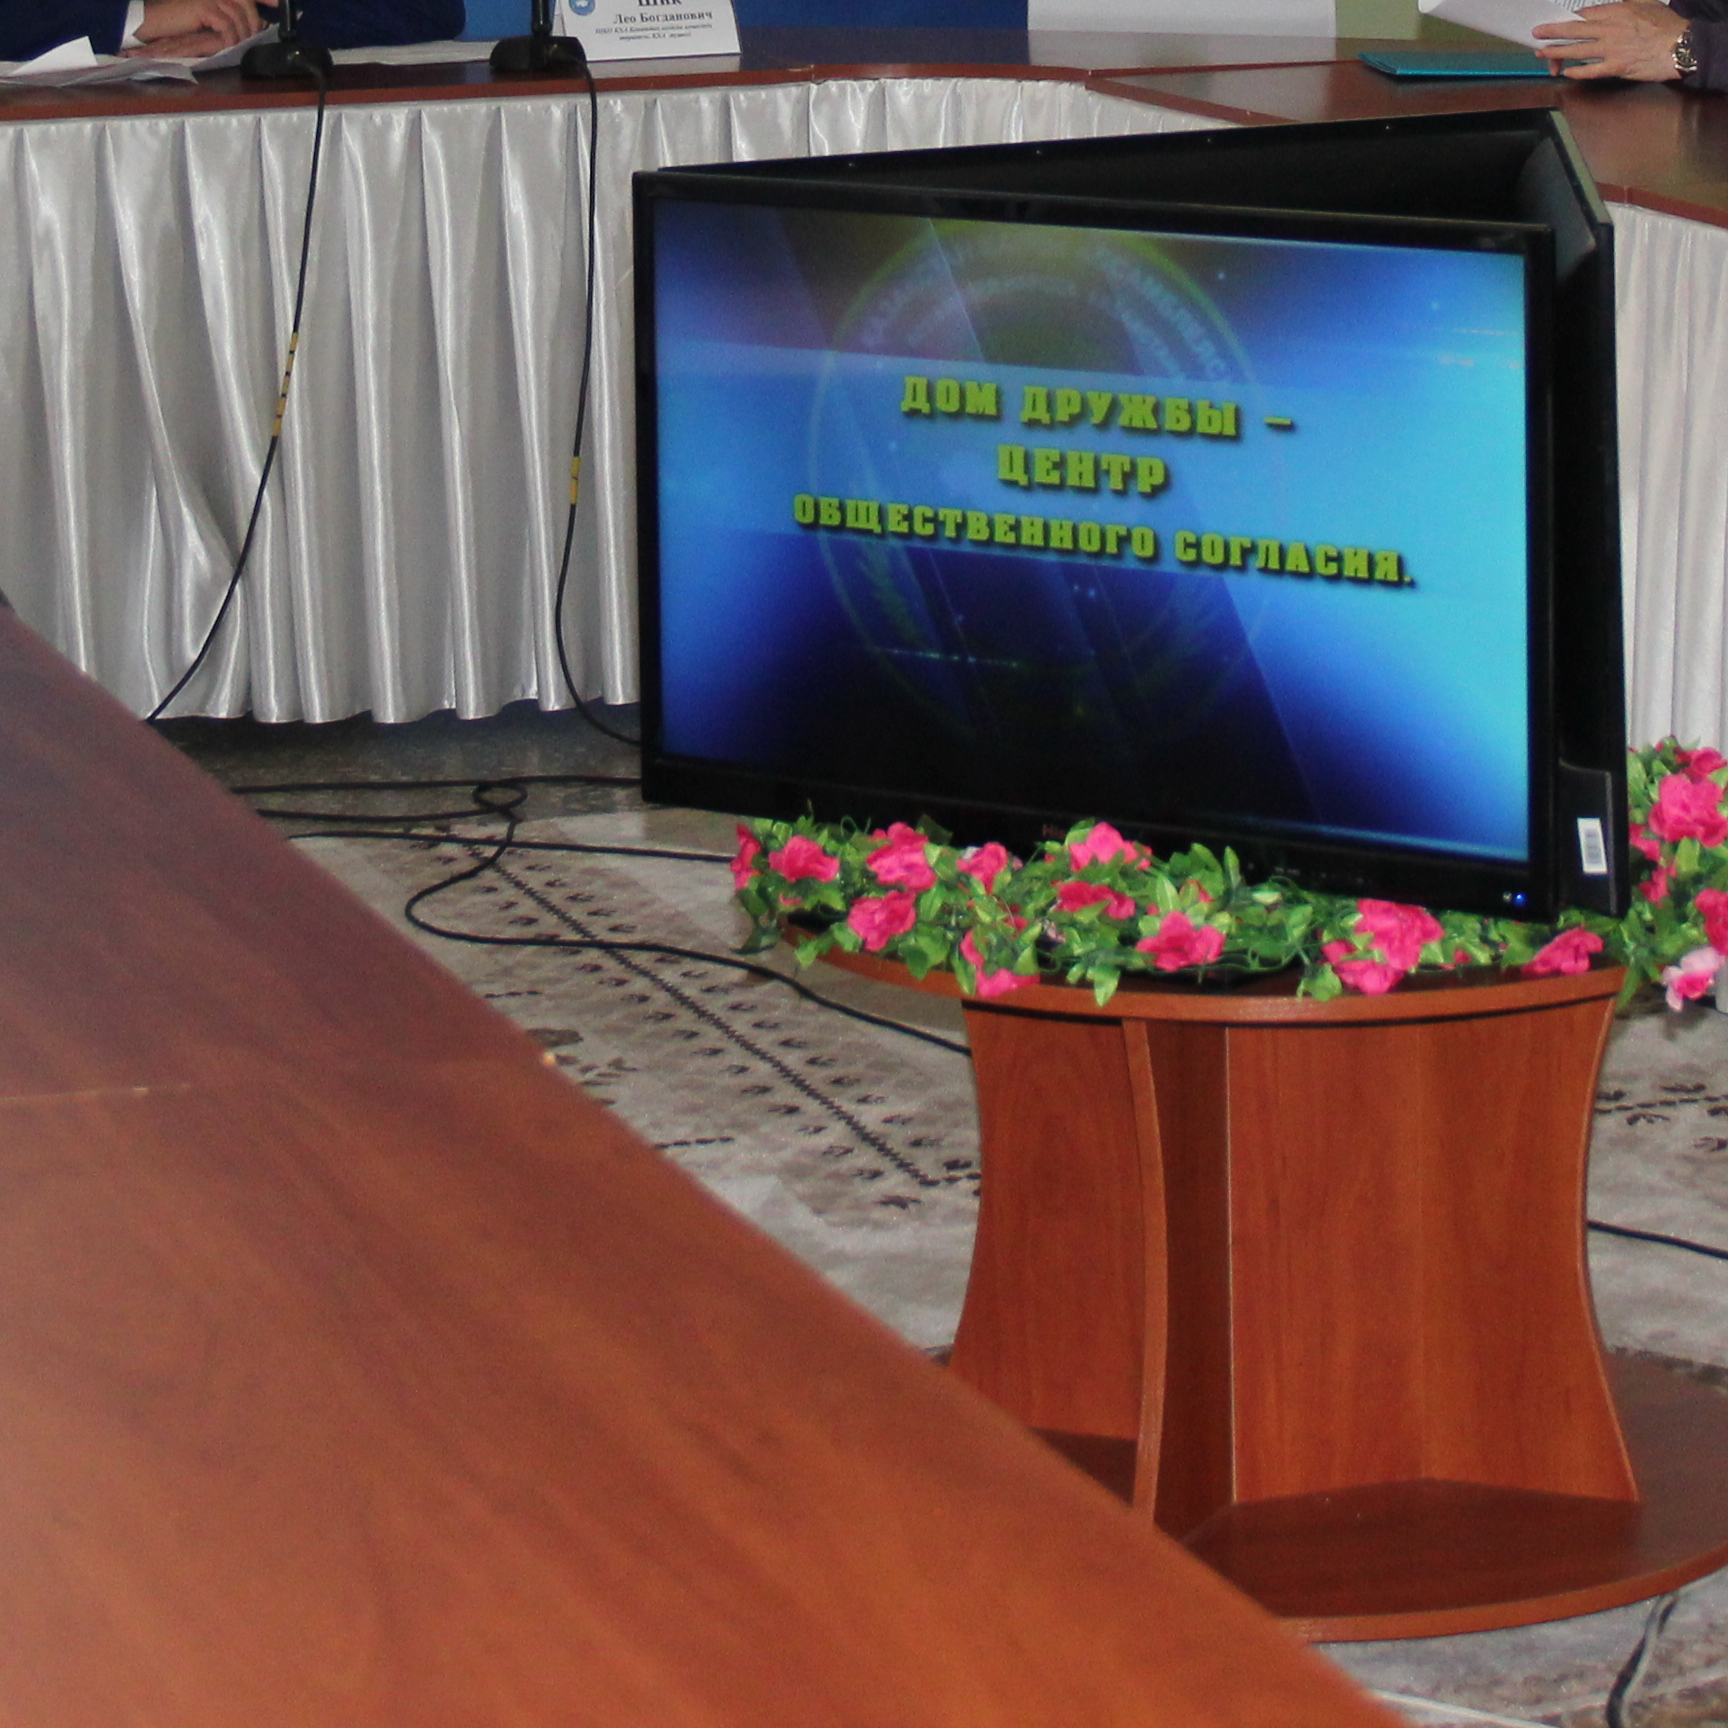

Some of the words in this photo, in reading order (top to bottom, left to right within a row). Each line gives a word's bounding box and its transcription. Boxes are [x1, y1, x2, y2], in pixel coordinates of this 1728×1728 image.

[613, 14, 637, 25] Лео
[640, 11, 713, 24] Богданович
[901, 375, 998, 418] ДОМ
[1020, 385, 1237, 437] ДРУЖБЫ
[997, 444, 1166, 494] ЦЕНТР
[793, 492, 1156, 559] ОБЩЕСТВЕННОГО
[1175, 529, 1413, 584] СОГЛАСИЯ.
